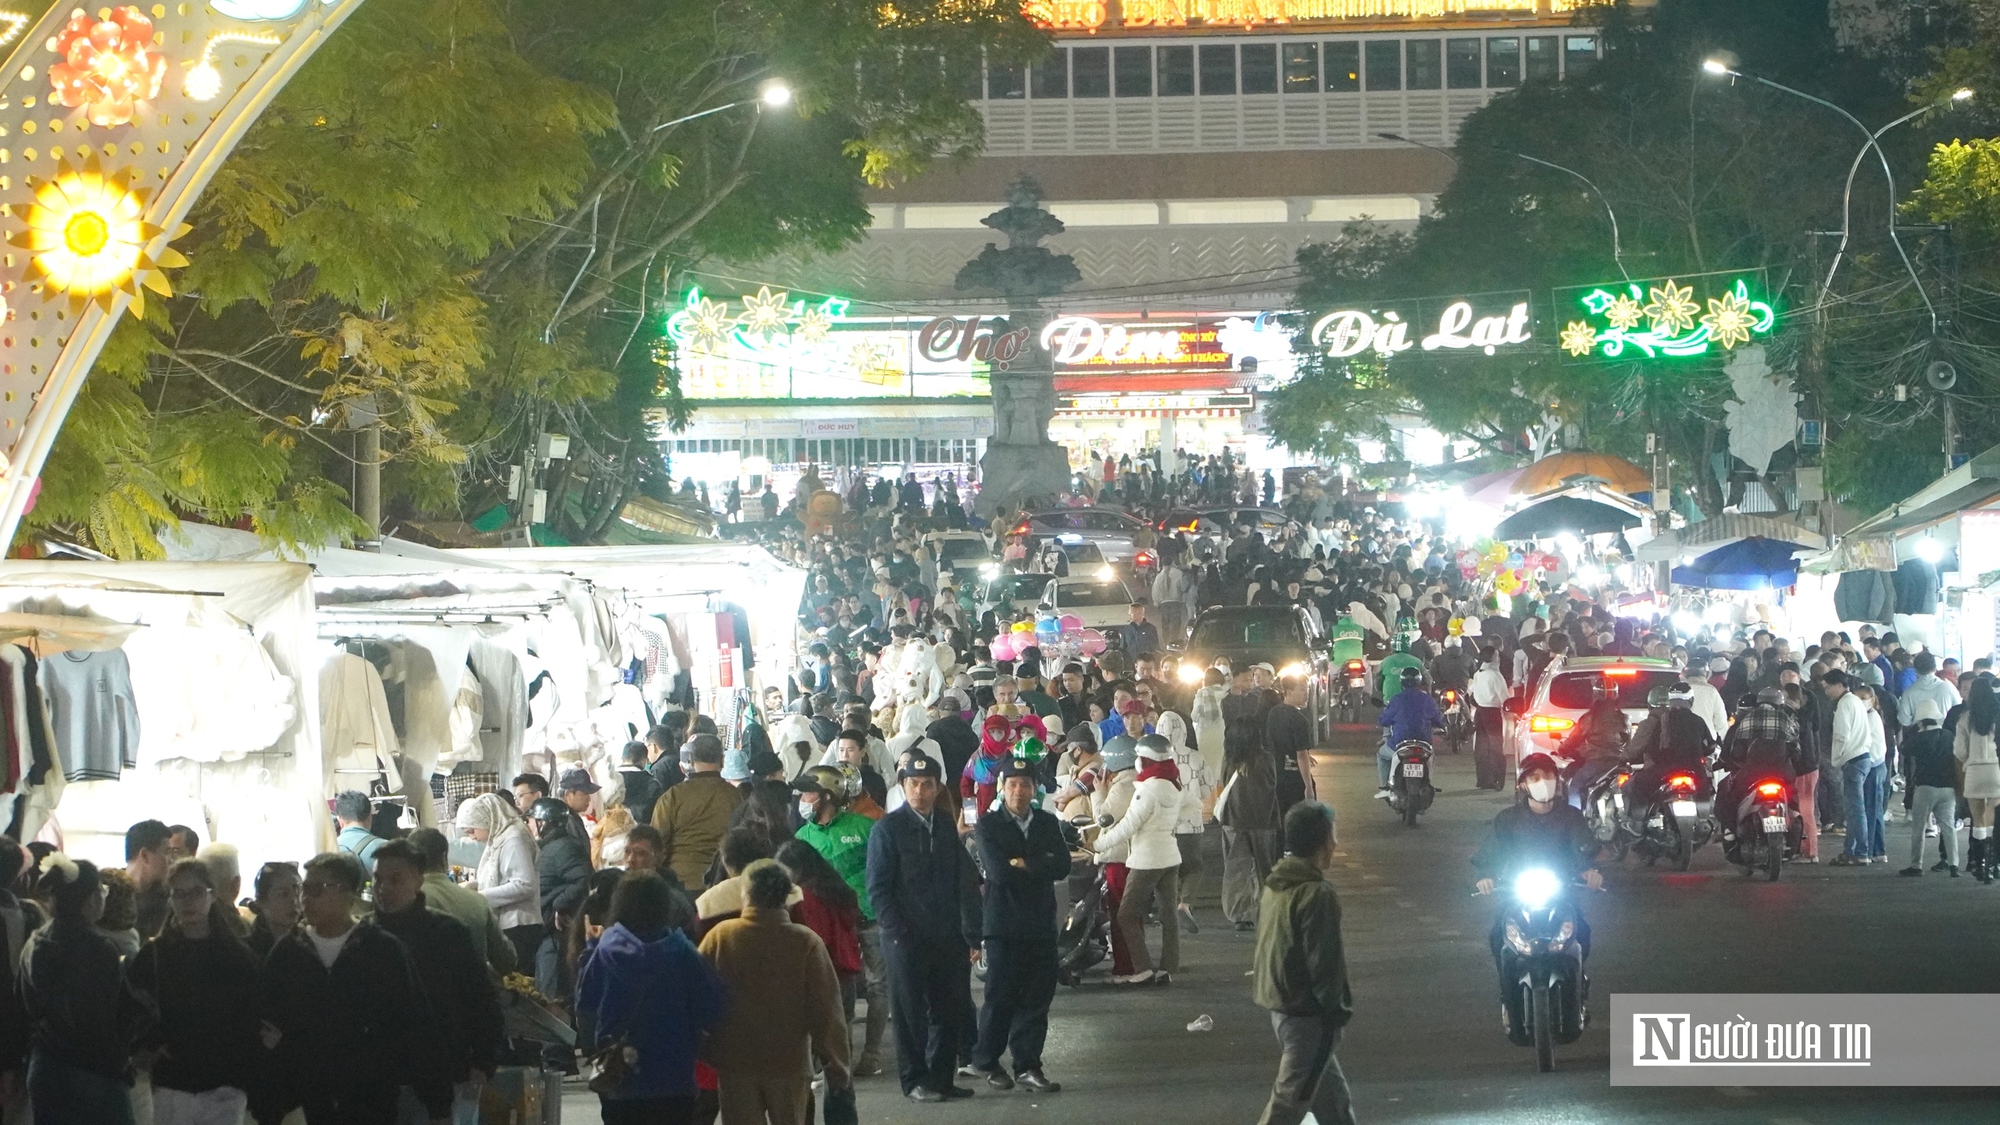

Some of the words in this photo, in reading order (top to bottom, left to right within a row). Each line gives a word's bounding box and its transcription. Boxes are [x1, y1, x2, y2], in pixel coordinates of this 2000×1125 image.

[918, 315, 1030, 371] Chợ
[1311, 310, 1413, 357] Đà
[1421, 301, 1531, 356] Lạt
[841, 834, 861, 844] Grab
